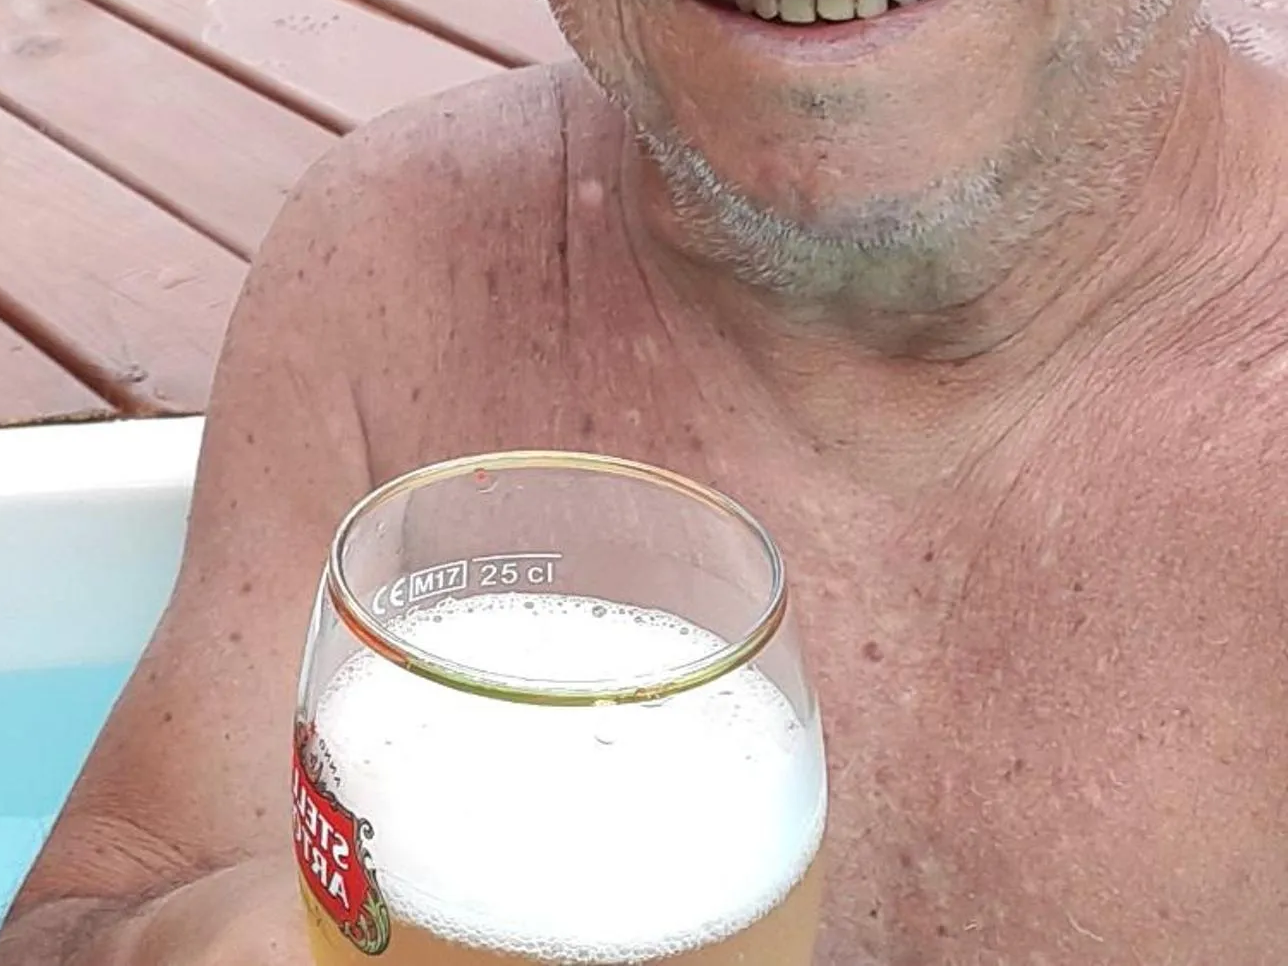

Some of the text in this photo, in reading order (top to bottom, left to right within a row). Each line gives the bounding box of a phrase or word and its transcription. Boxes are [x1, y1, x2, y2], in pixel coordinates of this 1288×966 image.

[415, 567, 461, 596] M17
[480, 563, 518, 586] 25
[527, 562, 554, 583] cl
